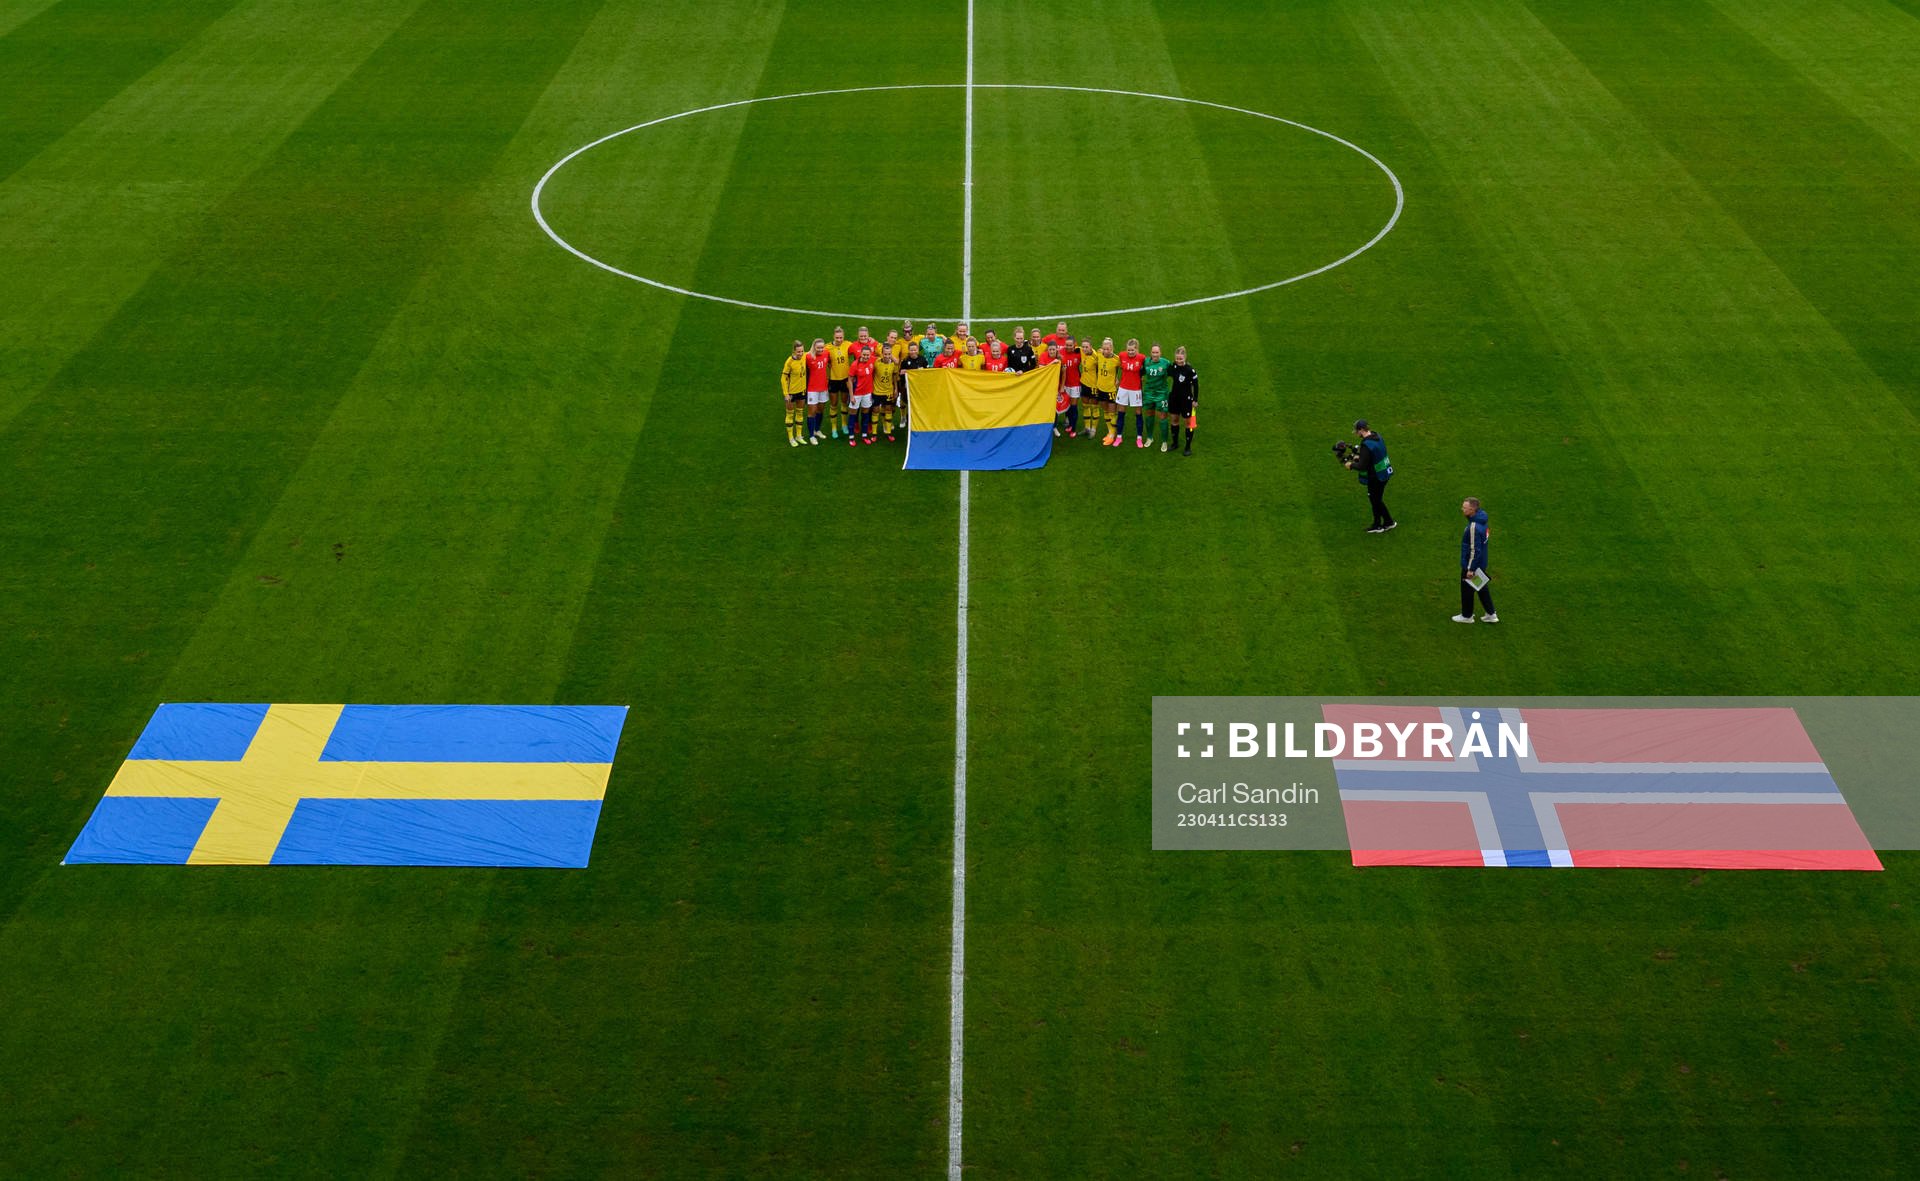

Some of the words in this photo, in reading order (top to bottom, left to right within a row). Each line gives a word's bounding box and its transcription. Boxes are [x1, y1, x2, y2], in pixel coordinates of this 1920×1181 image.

[836, 356, 845, 364] 18
[817, 361, 824, 369] 21
[1126, 363, 1134, 371] 14
[1149, 368, 1158, 376] 23
[881, 376, 890, 384] 25
